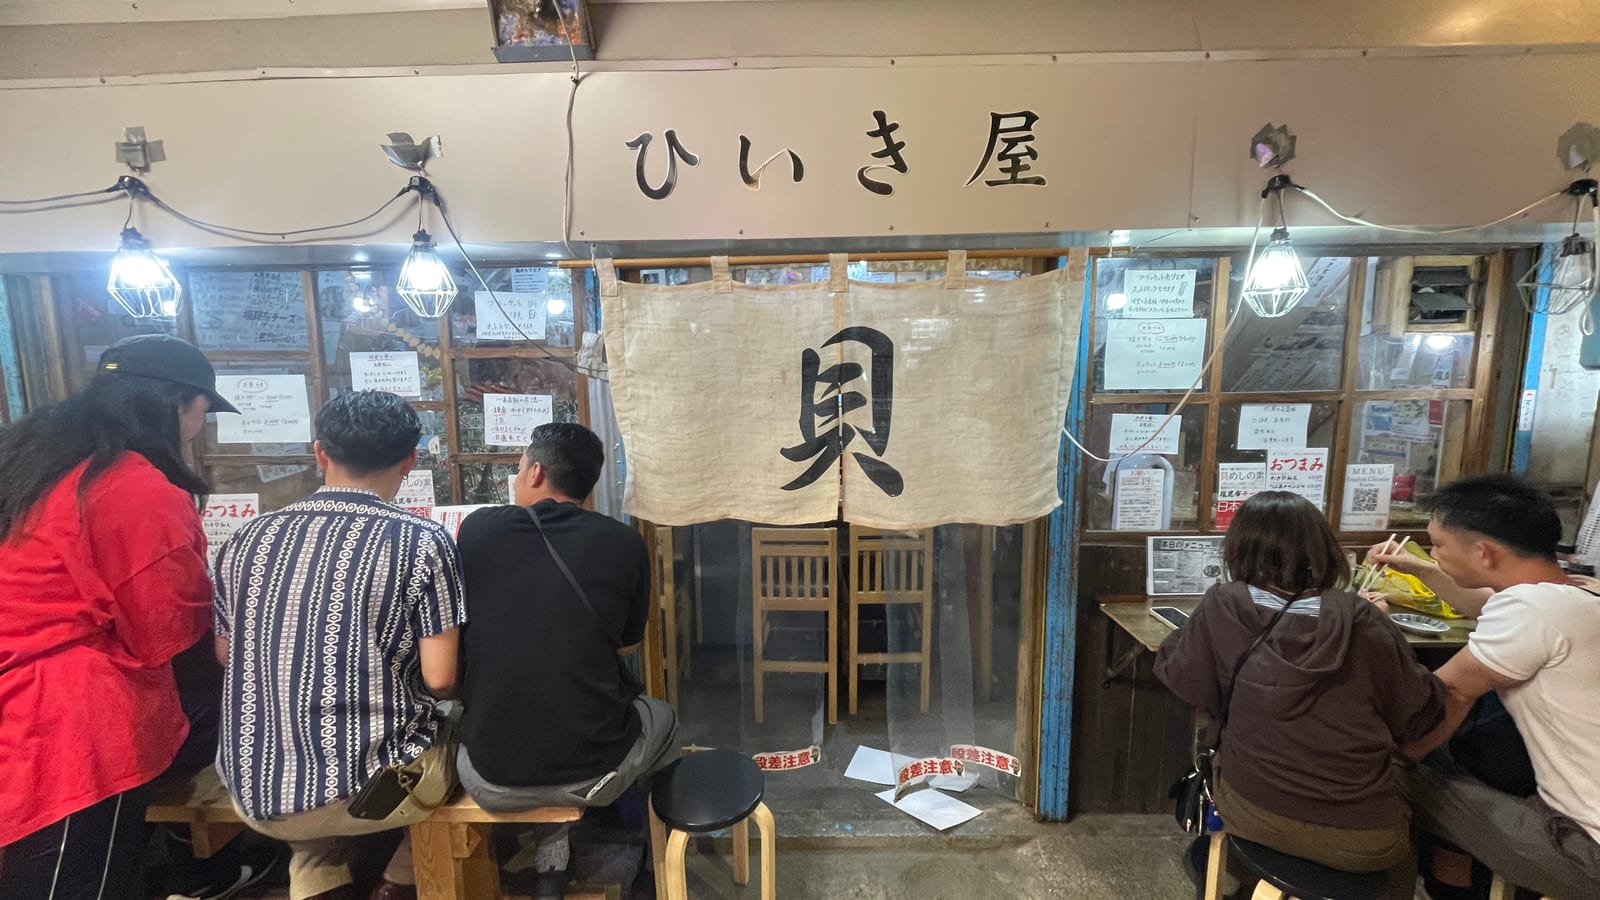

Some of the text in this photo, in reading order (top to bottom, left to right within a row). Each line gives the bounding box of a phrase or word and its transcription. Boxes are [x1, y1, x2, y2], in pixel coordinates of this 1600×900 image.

[625, 110, 1047, 200] ひいき屋
[780, 326, 904, 497] 貝
[1270, 457, 1324, 471] おつまみ
[1161, 541, 1212, 549] 本日のメニュー
